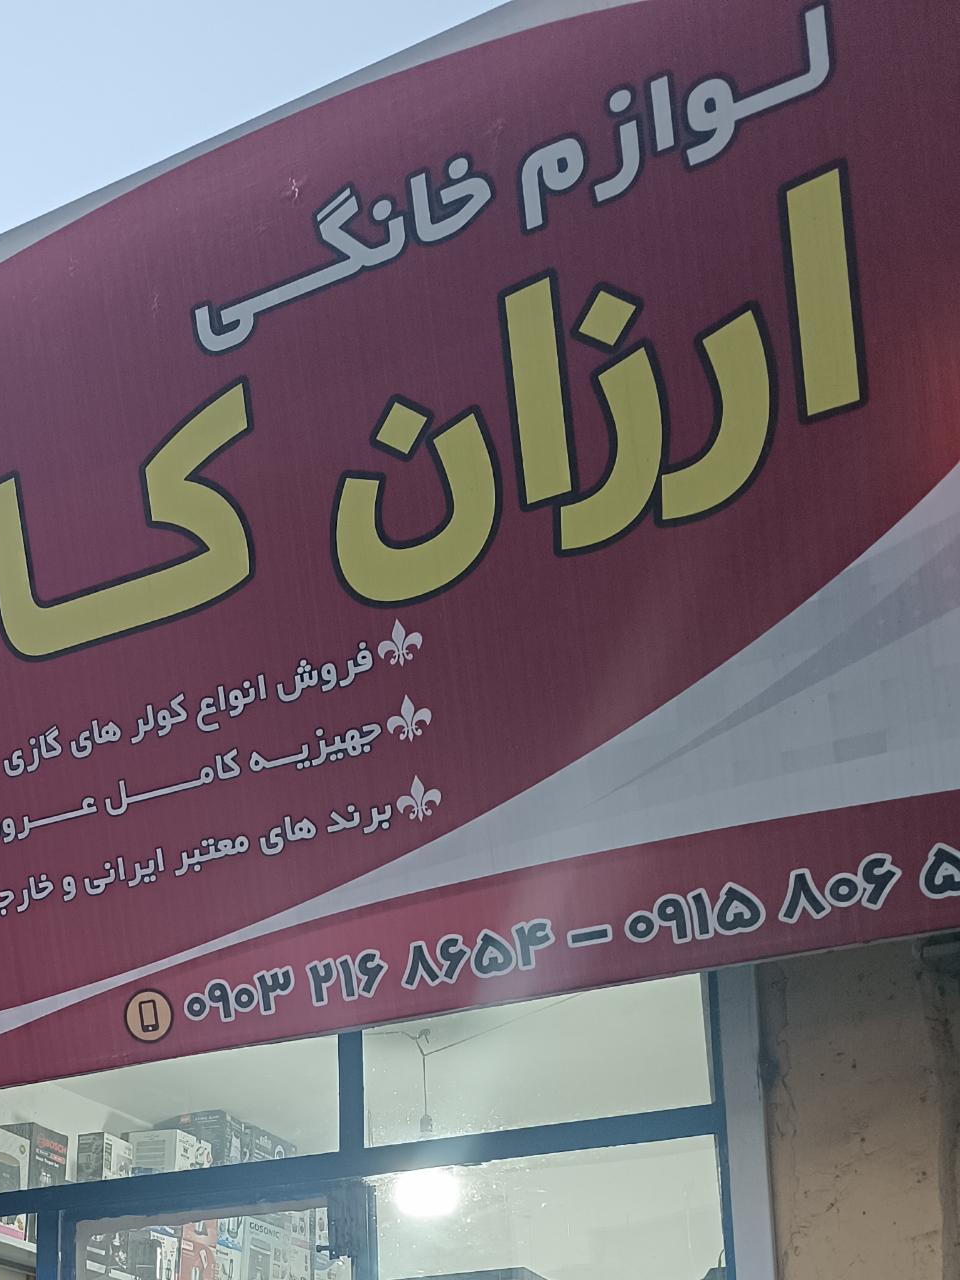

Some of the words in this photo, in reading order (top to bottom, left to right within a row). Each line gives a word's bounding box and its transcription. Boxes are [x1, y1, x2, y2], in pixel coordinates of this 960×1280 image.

[522, 3, 833, 231] لوازم
[193, 156, 494, 353] خانگی
[334, 162, 863, 606] ارزان
[276, 642, 375, 704] فروش
[131, 694, 187, 744] کولر
[196, 674, 266, 732] انواع
[3, 726, 64, 779] گازی
[69, 719, 122, 759] های
[250, 720, 383, 772] جهیزیه
[104, 750, 240, 813] کامل
[259, 815, 317, 856] های
[326, 801, 392, 835] برند
[83, 848, 166, 899] ایرانی
[175, 832, 250, 878] معتبر
[61, 877, 77, 902] و
[183, 971, 296, 1023] ۰۹۰۳
[306, 950, 390, 1005] ۲۱۶
[400, 918, 553, 992] ۸۶۵۴
[623, 882, 767, 947] ۰۹۱۵
[778, 843, 903, 926] ۸۰۶
[249, 1221, 281, 1239] GOSONIC
